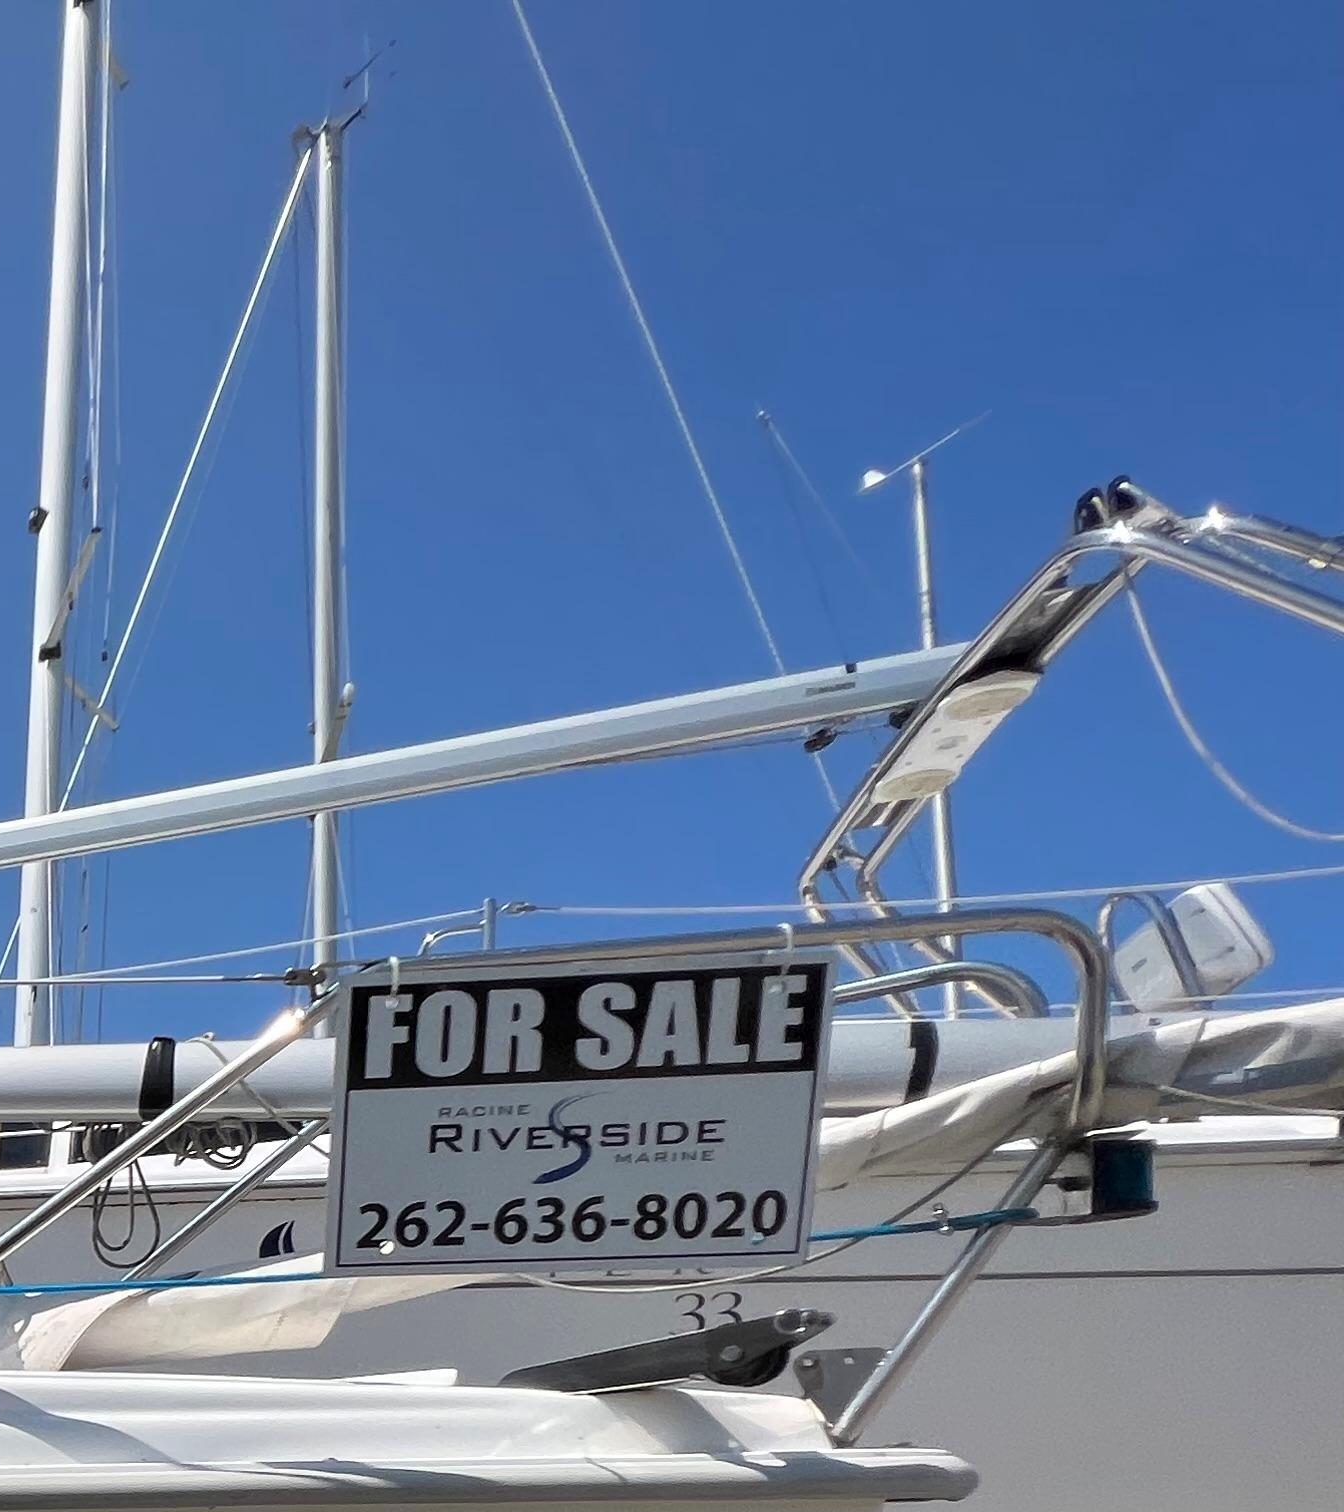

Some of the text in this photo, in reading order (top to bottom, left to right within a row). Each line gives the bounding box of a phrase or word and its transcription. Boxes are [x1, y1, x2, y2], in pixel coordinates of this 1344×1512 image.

[364, 975, 808, 1079] FOR SALE
[438, 1103, 531, 1118] RACINE
[615, 1149, 716, 1163] MARINE
[356, 1189, 789, 1250] 262-636-8020
